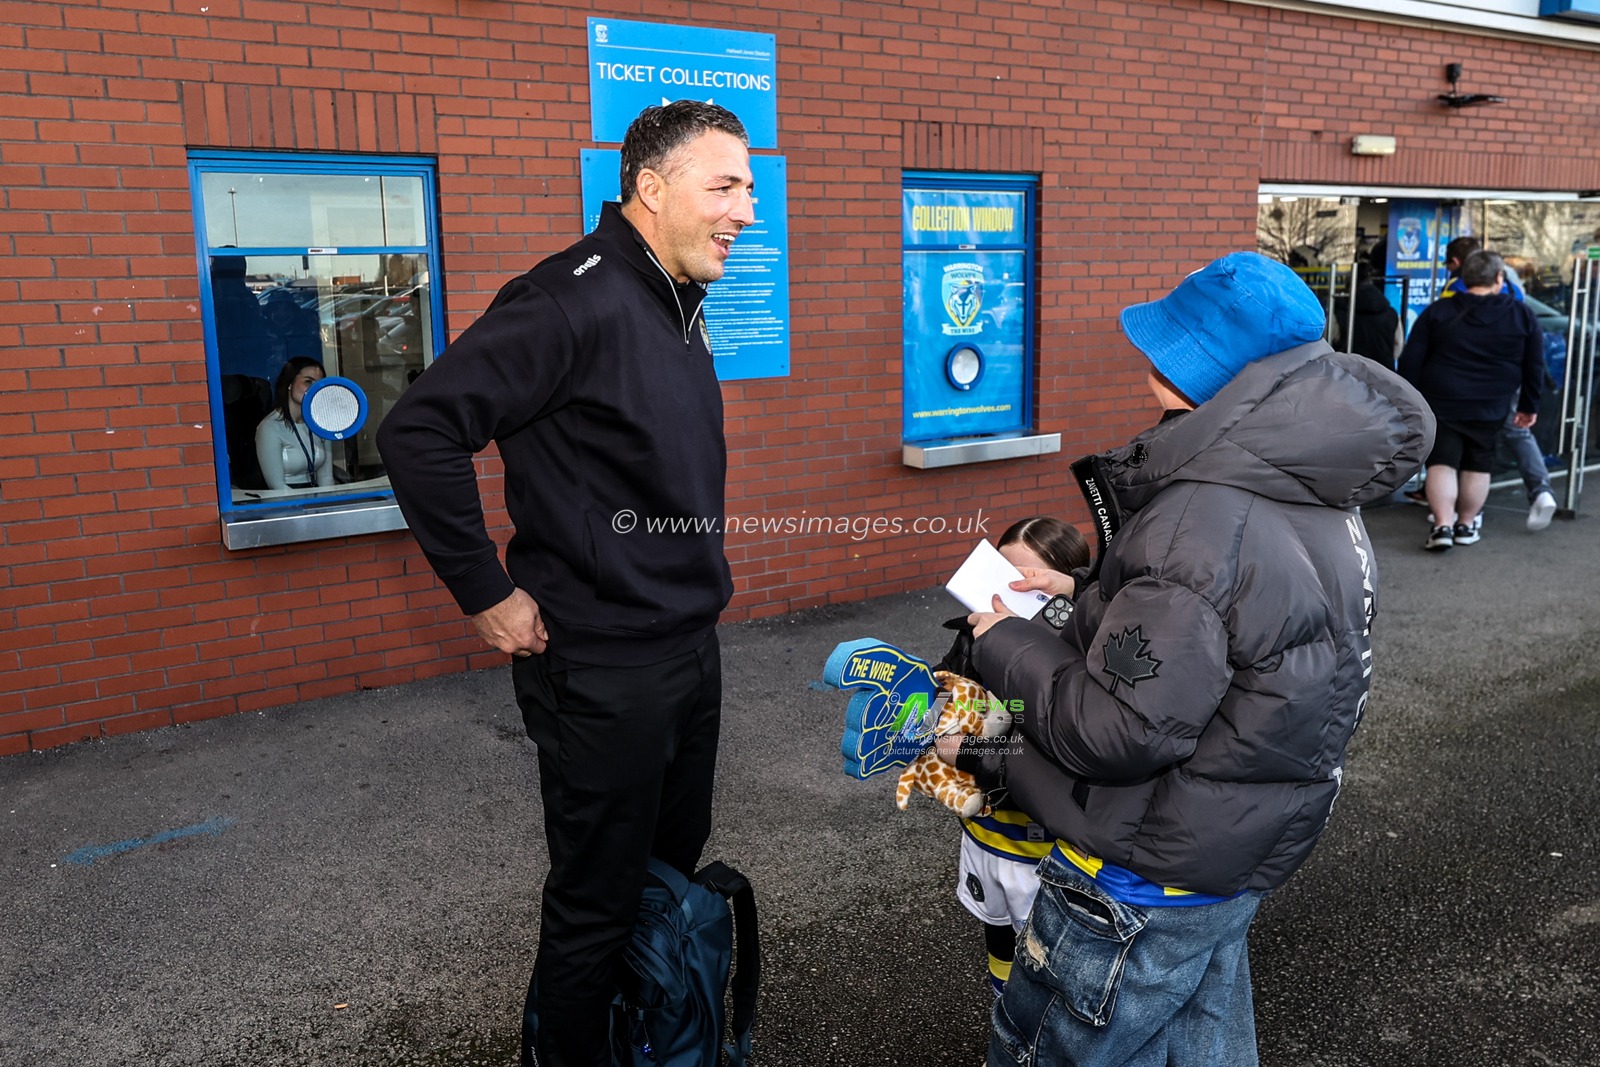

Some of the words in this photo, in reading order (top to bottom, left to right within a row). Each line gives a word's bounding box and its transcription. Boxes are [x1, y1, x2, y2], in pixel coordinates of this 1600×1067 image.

[596, 62, 655, 83] TICKET
[660, 67, 771, 91] COLLECTIONS
[912, 205, 970, 231] COLLECTION
[972, 206, 1014, 232] WINDOW
[912, 404, 1011, 419] www.warringtonwolves.com
[1085, 477, 1103, 506] ZAVETTI
[849, 657, 871, 678] THE
[869, 660, 897, 683] WIRE
